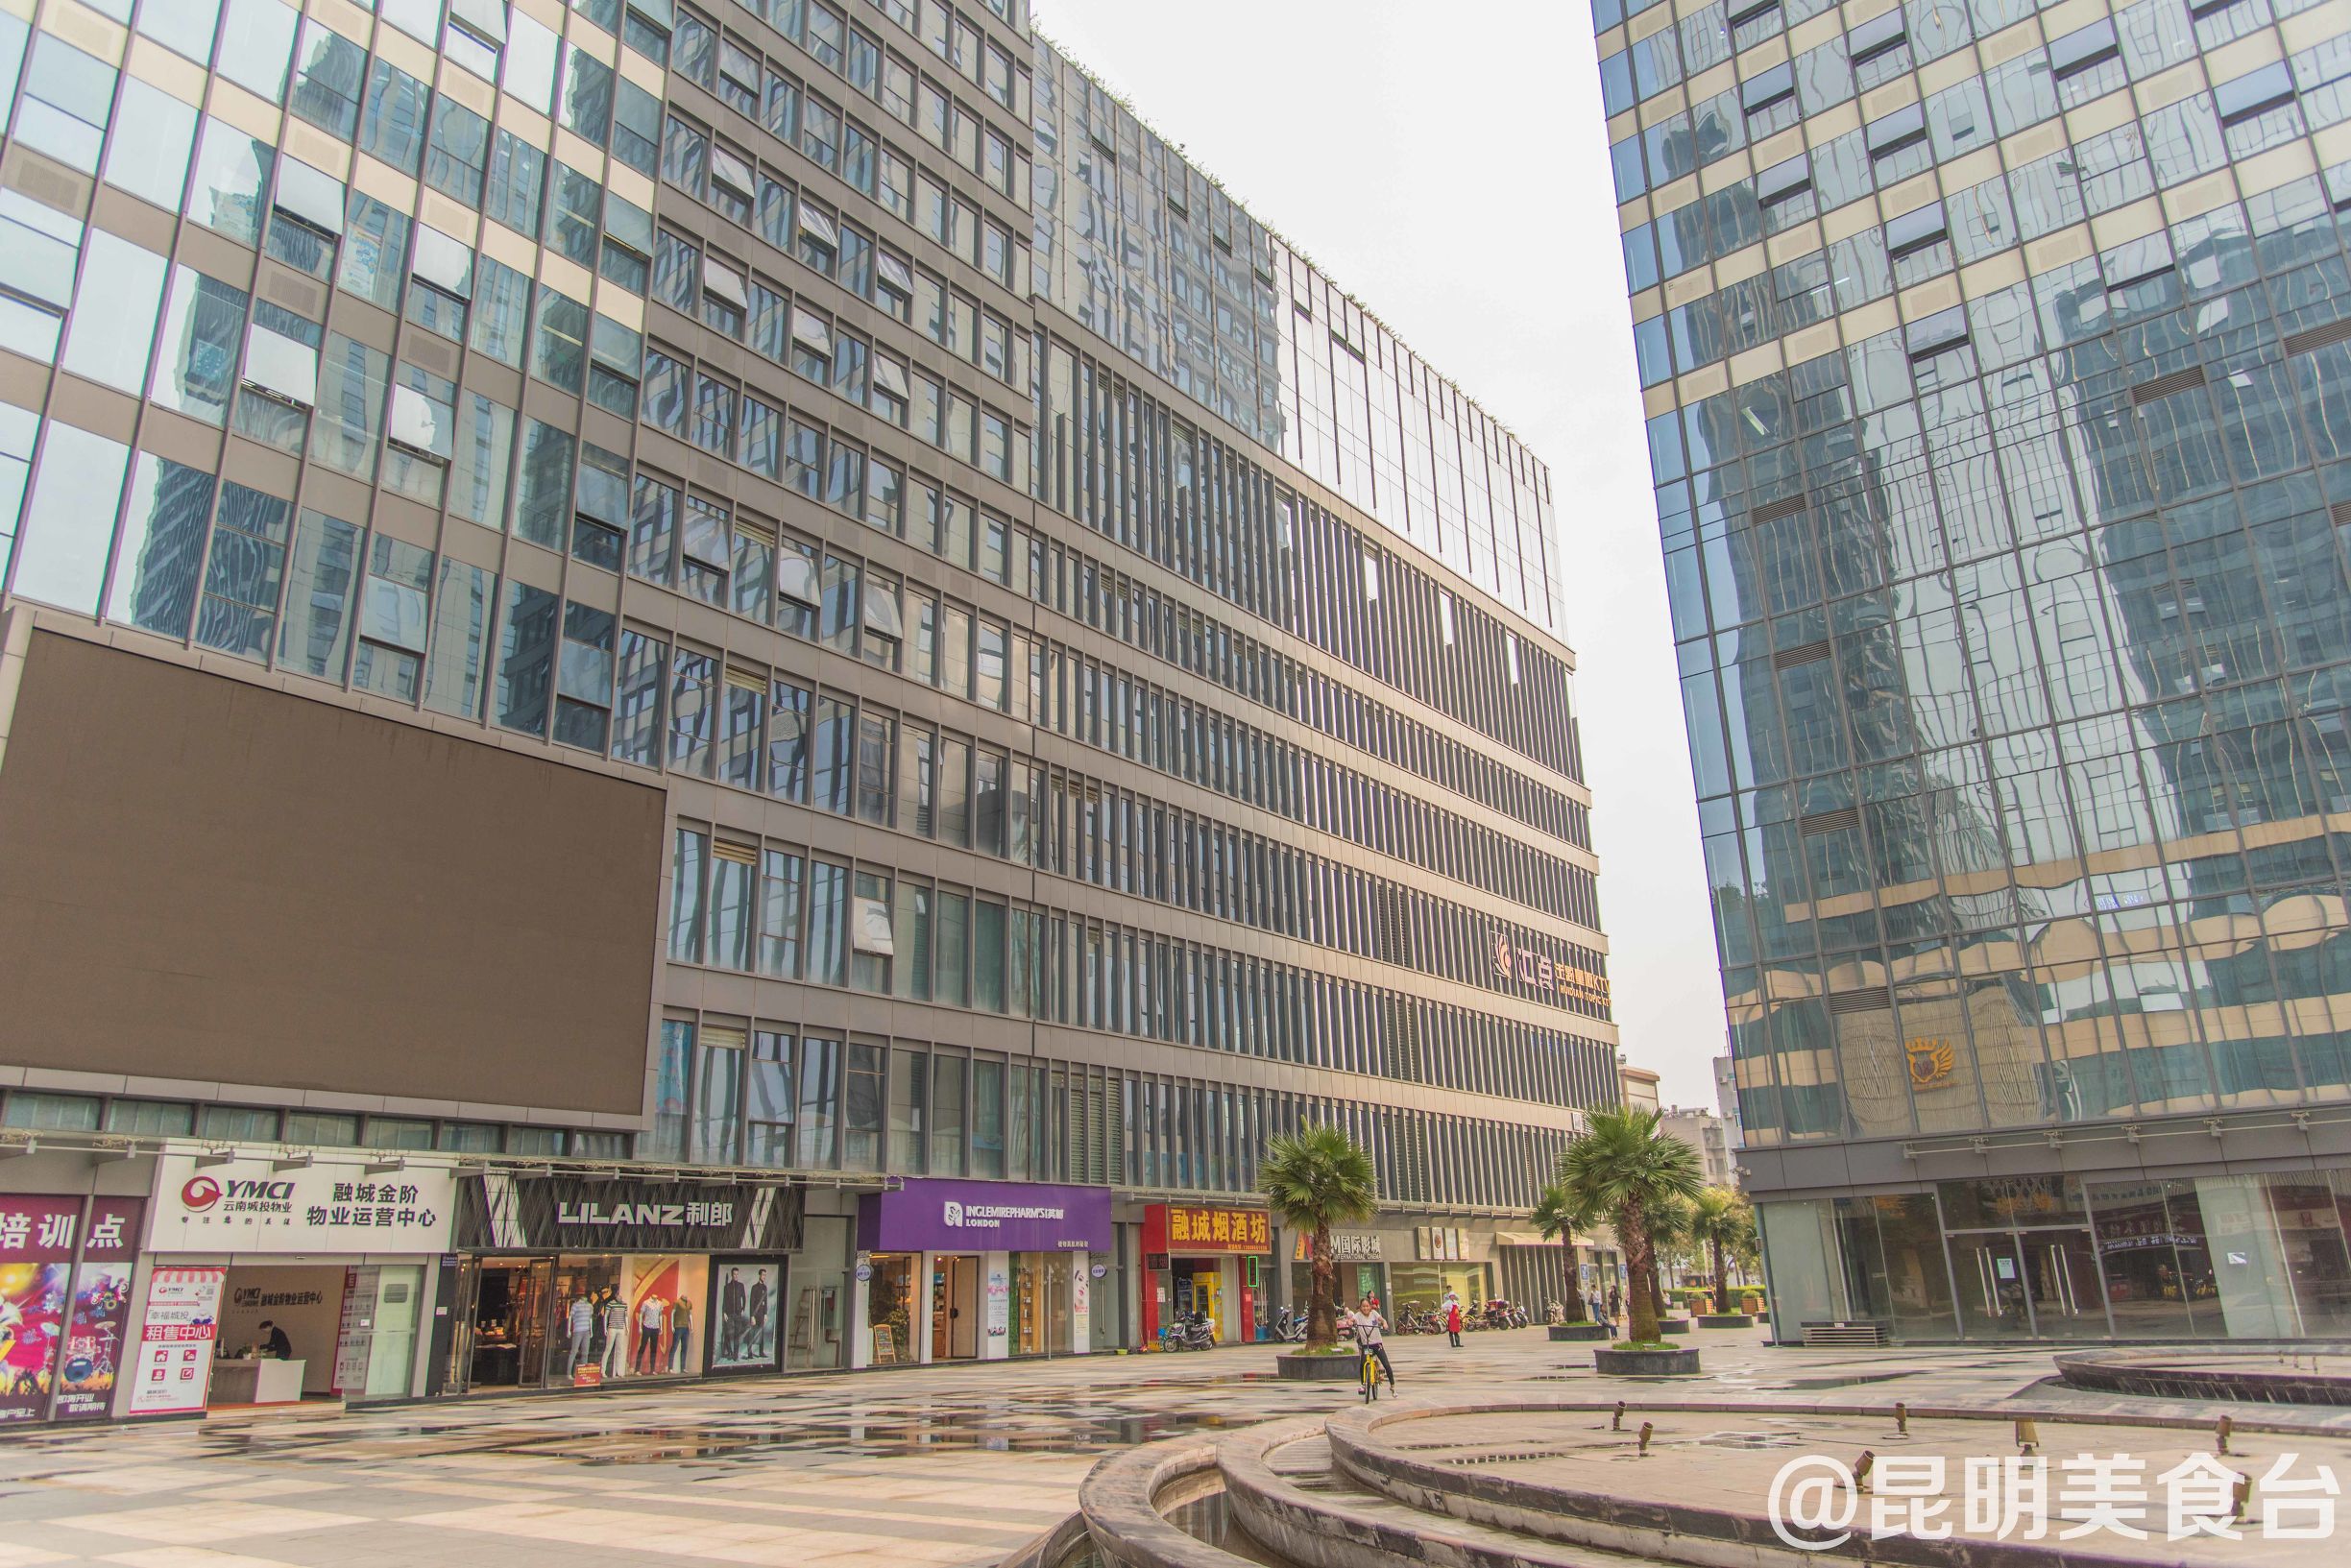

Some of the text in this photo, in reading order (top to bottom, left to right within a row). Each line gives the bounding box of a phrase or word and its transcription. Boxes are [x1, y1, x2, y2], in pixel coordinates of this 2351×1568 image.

[227, 1180, 296, 1199] YMCI
[333, 1182, 419, 1204] 融城金阶
[224, 1200, 293, 1213] 云南城投物业
[306, 1206, 437, 1227] 物业运营中心
[557, 1201, 733, 1227] LILANZ 利郎
[966, 1219, 1001, 1228] LONDON
[1171, 1208, 1267, 1243] 融城烟酒坊
[146, 1325, 211, 1340] 租售中心
